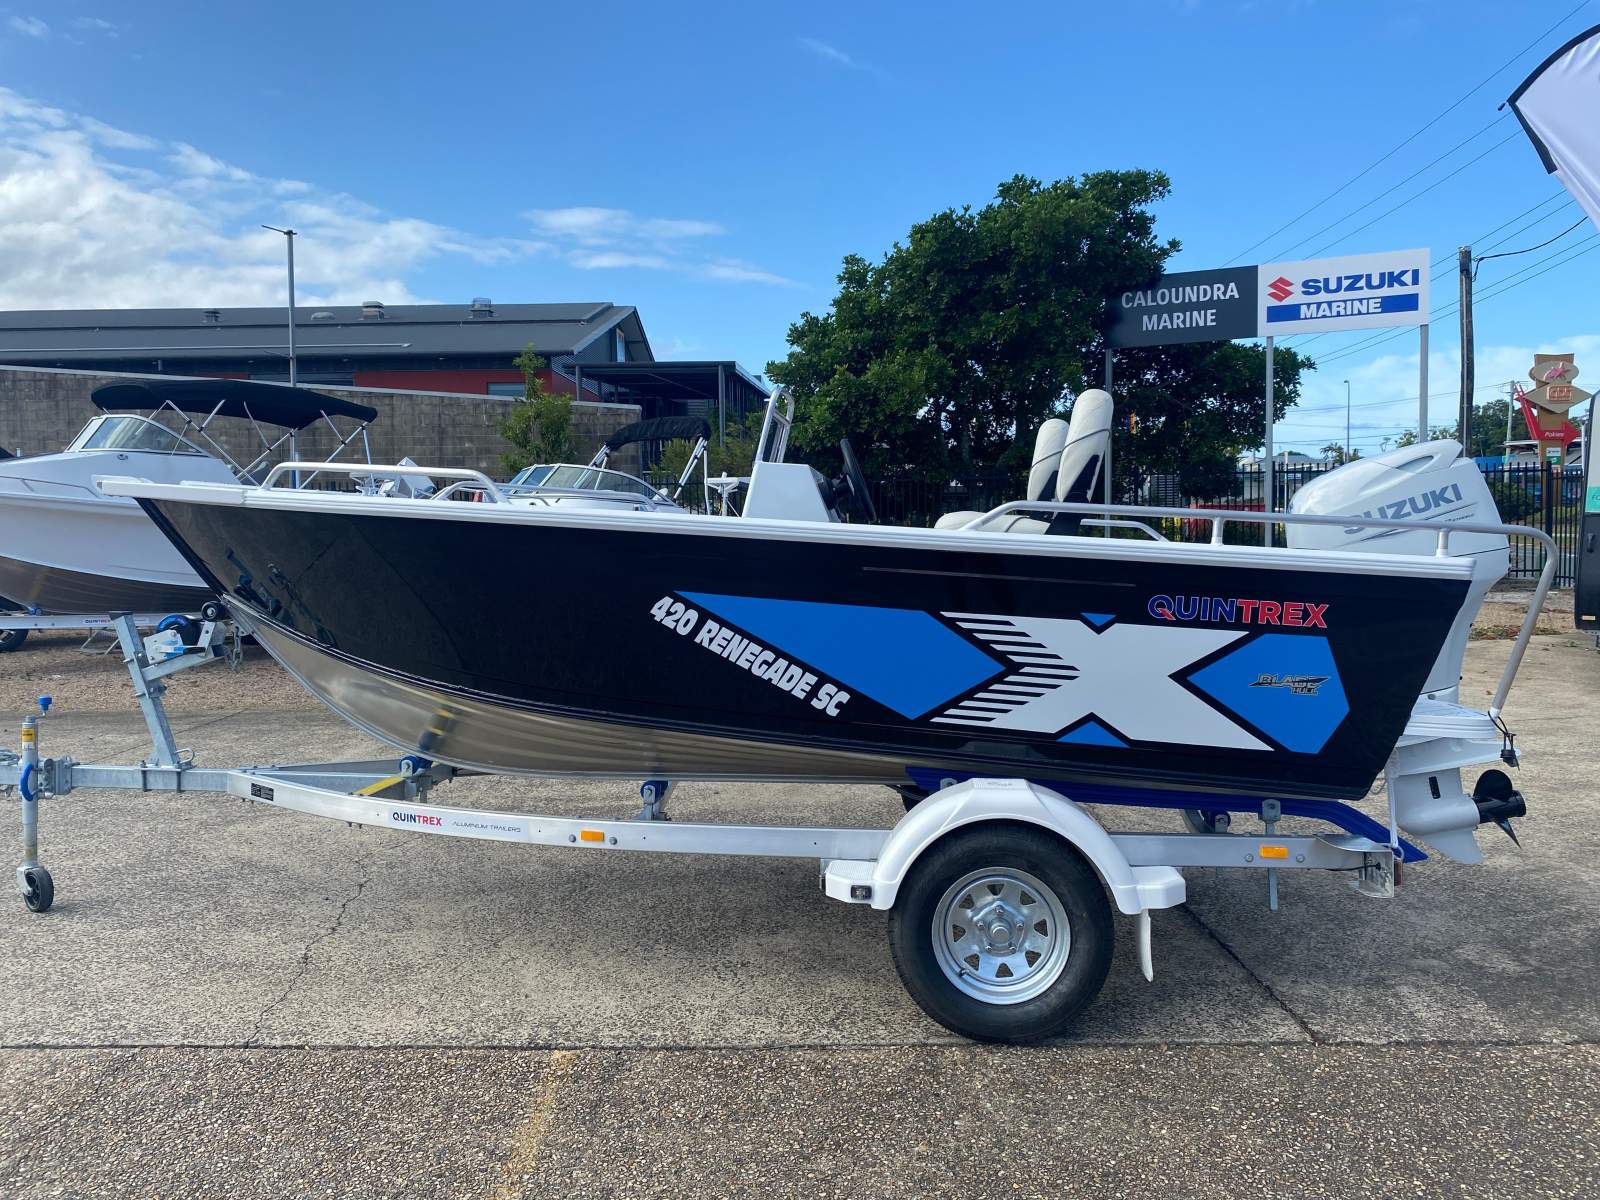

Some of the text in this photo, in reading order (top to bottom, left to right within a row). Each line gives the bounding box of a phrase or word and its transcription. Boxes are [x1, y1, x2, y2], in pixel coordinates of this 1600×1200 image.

[1121, 282, 1239, 309] CALOUNDRA
[1301, 268, 1420, 296] SUZUKI
[1142, 309, 1217, 332] MARINE
[1300, 298, 1382, 320] MARINE
[1147, 594, 1329, 628] QUINTREX
[650, 596, 851, 717] 420 RENEGADE SC
[392, 811, 443, 826] QUINTREX
